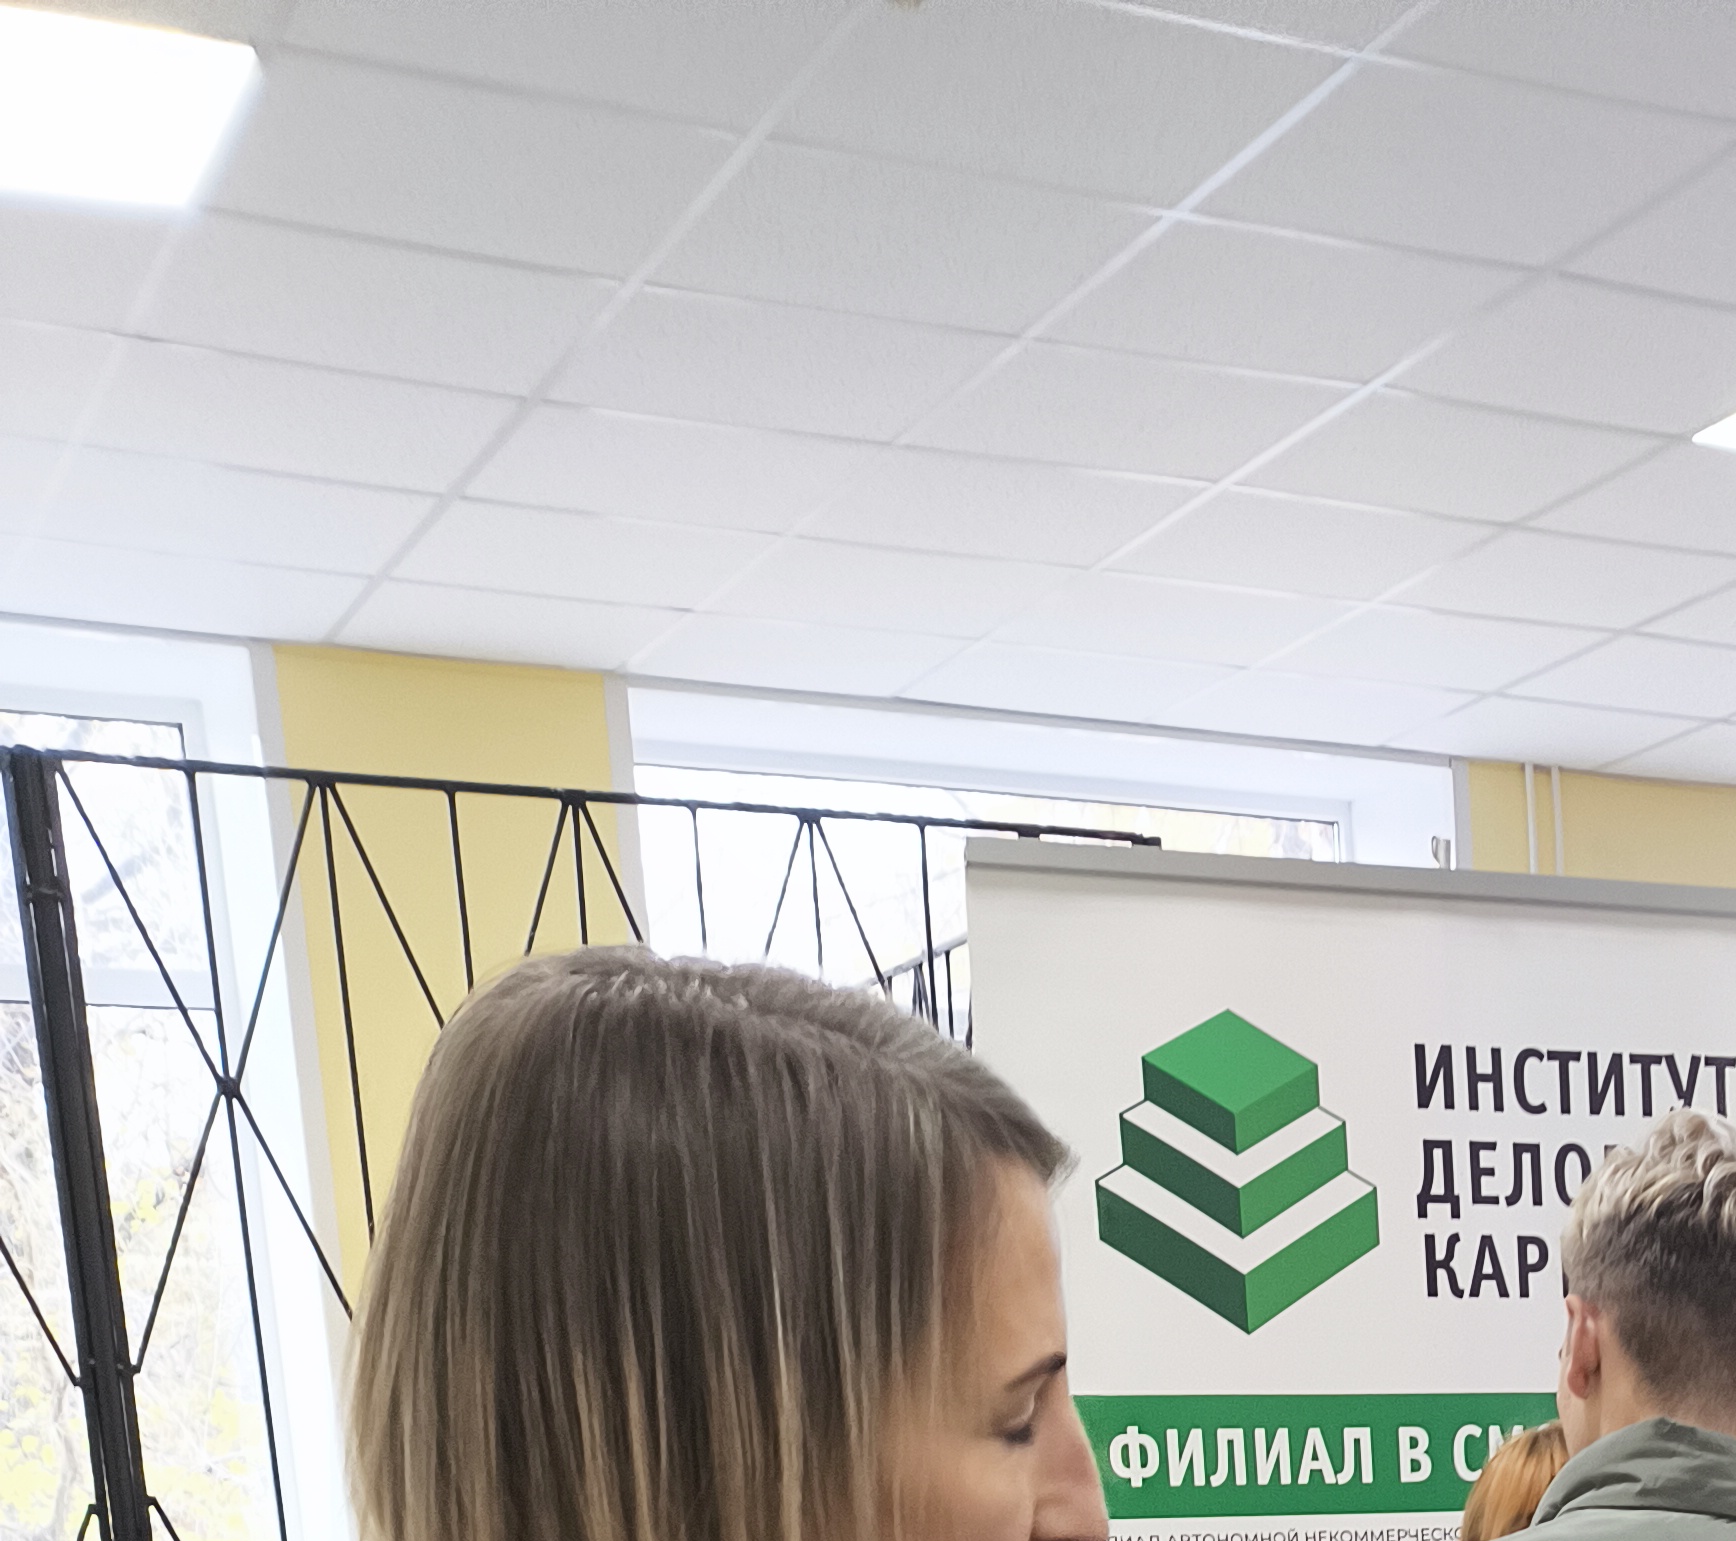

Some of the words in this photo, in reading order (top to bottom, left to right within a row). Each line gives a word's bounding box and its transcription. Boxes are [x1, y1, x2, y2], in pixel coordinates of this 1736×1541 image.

[1416, 1139, 1622, 1219] ДЕЛО
[1424, 1232, 1569, 1299] КАР
[1108, 1425, 1374, 1487] ФИЛИАЛ
[1398, 1425, 1433, 1483] В
